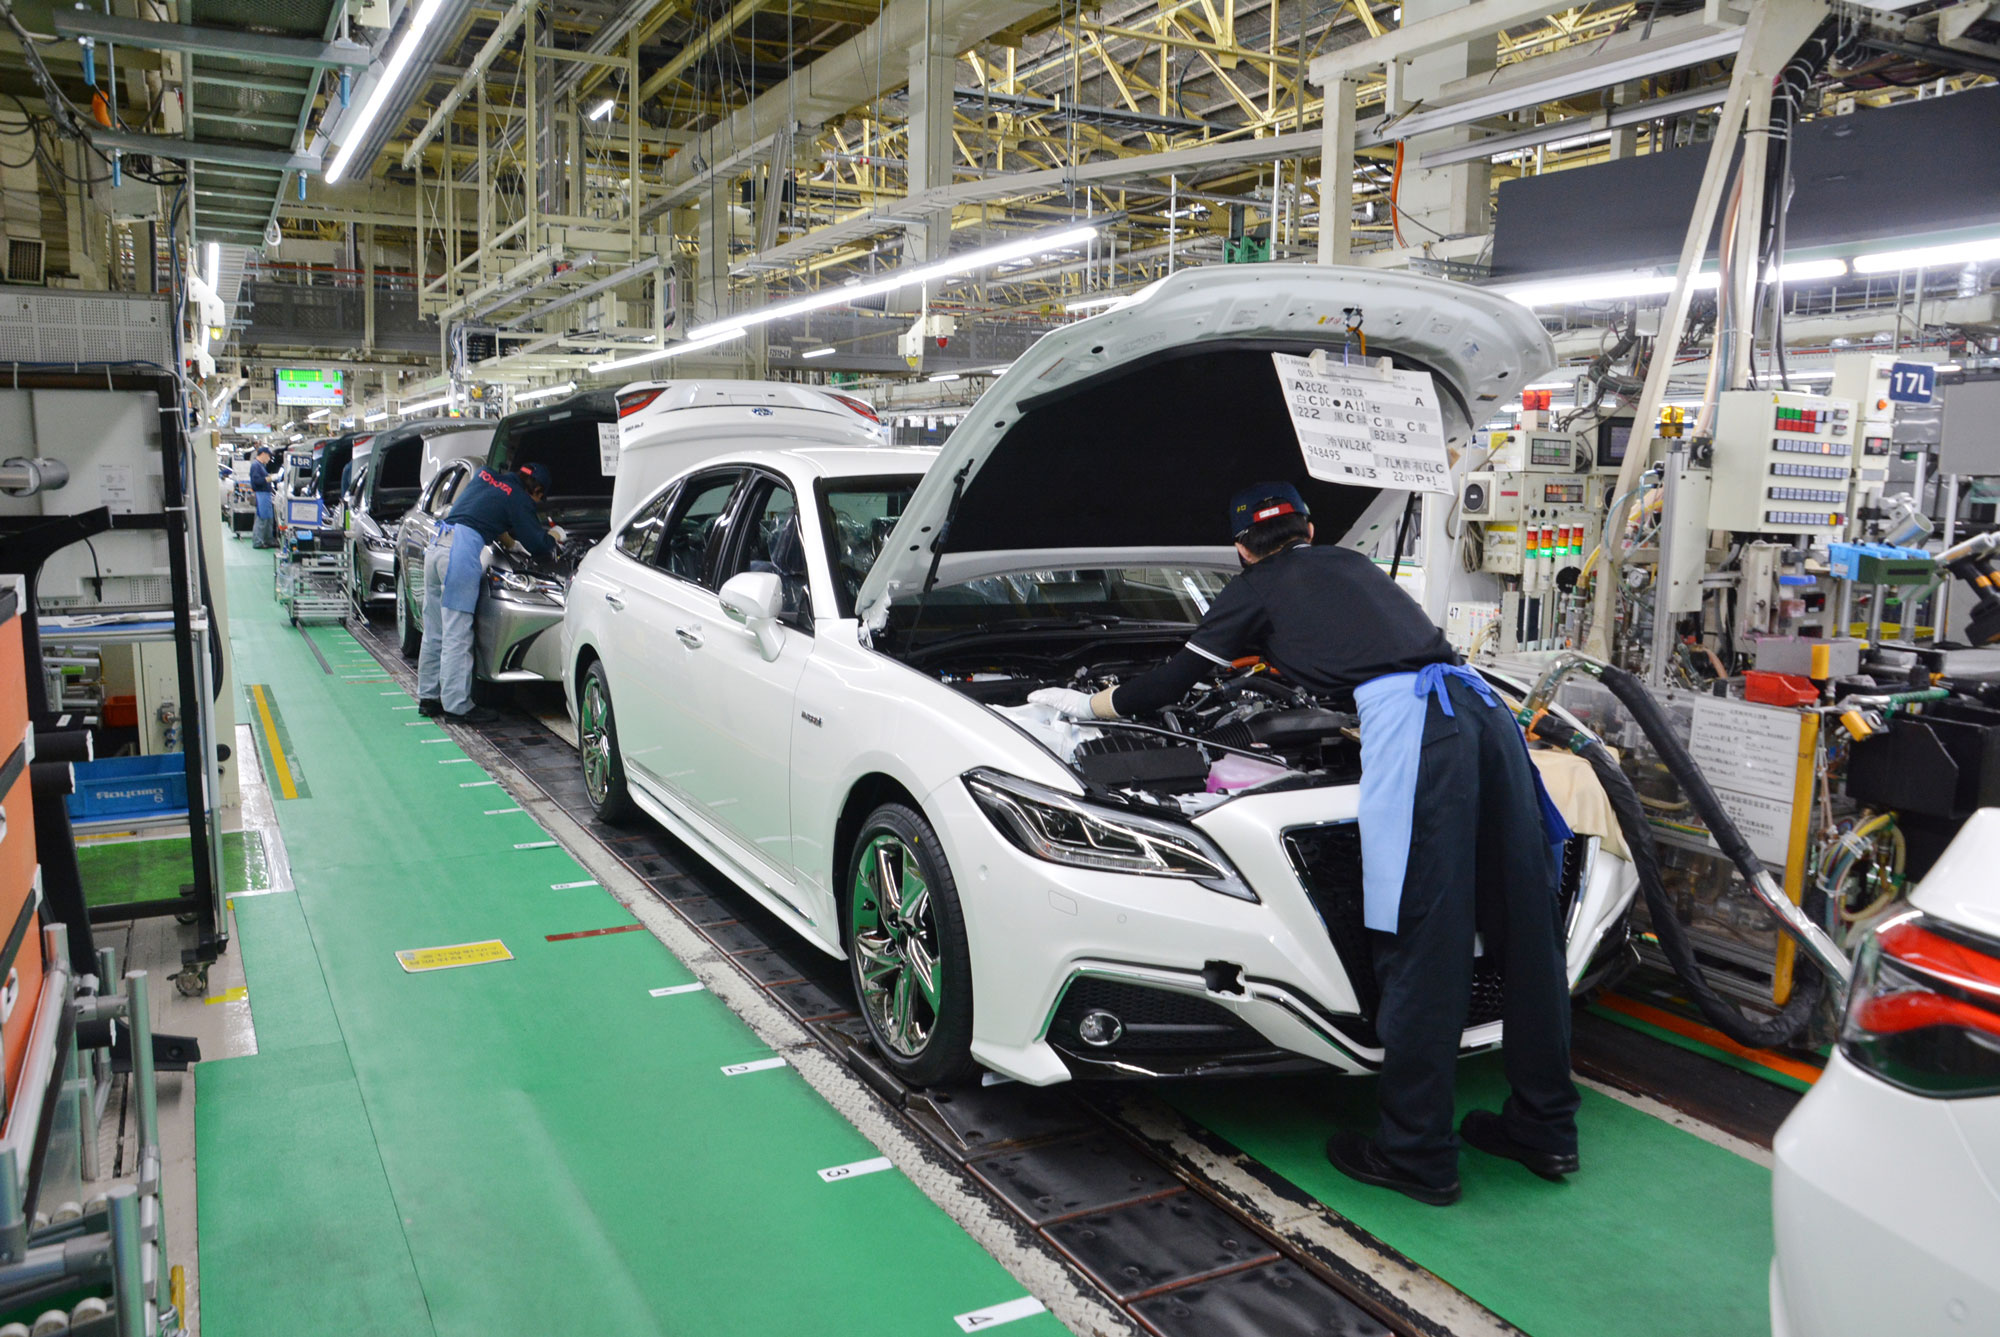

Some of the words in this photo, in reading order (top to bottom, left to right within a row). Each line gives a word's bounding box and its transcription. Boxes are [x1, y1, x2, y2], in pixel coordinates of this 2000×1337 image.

[1294, 380, 1329, 394] A2C2C
[1894, 371, 1931, 396] 17L
[1415, 396, 1425, 408] A
[1297, 406, 1321, 420] 222
[727, 1065, 749, 1074] 2
[826, 1168, 850, 1177] 3
[967, 1316, 994, 1327] 4
